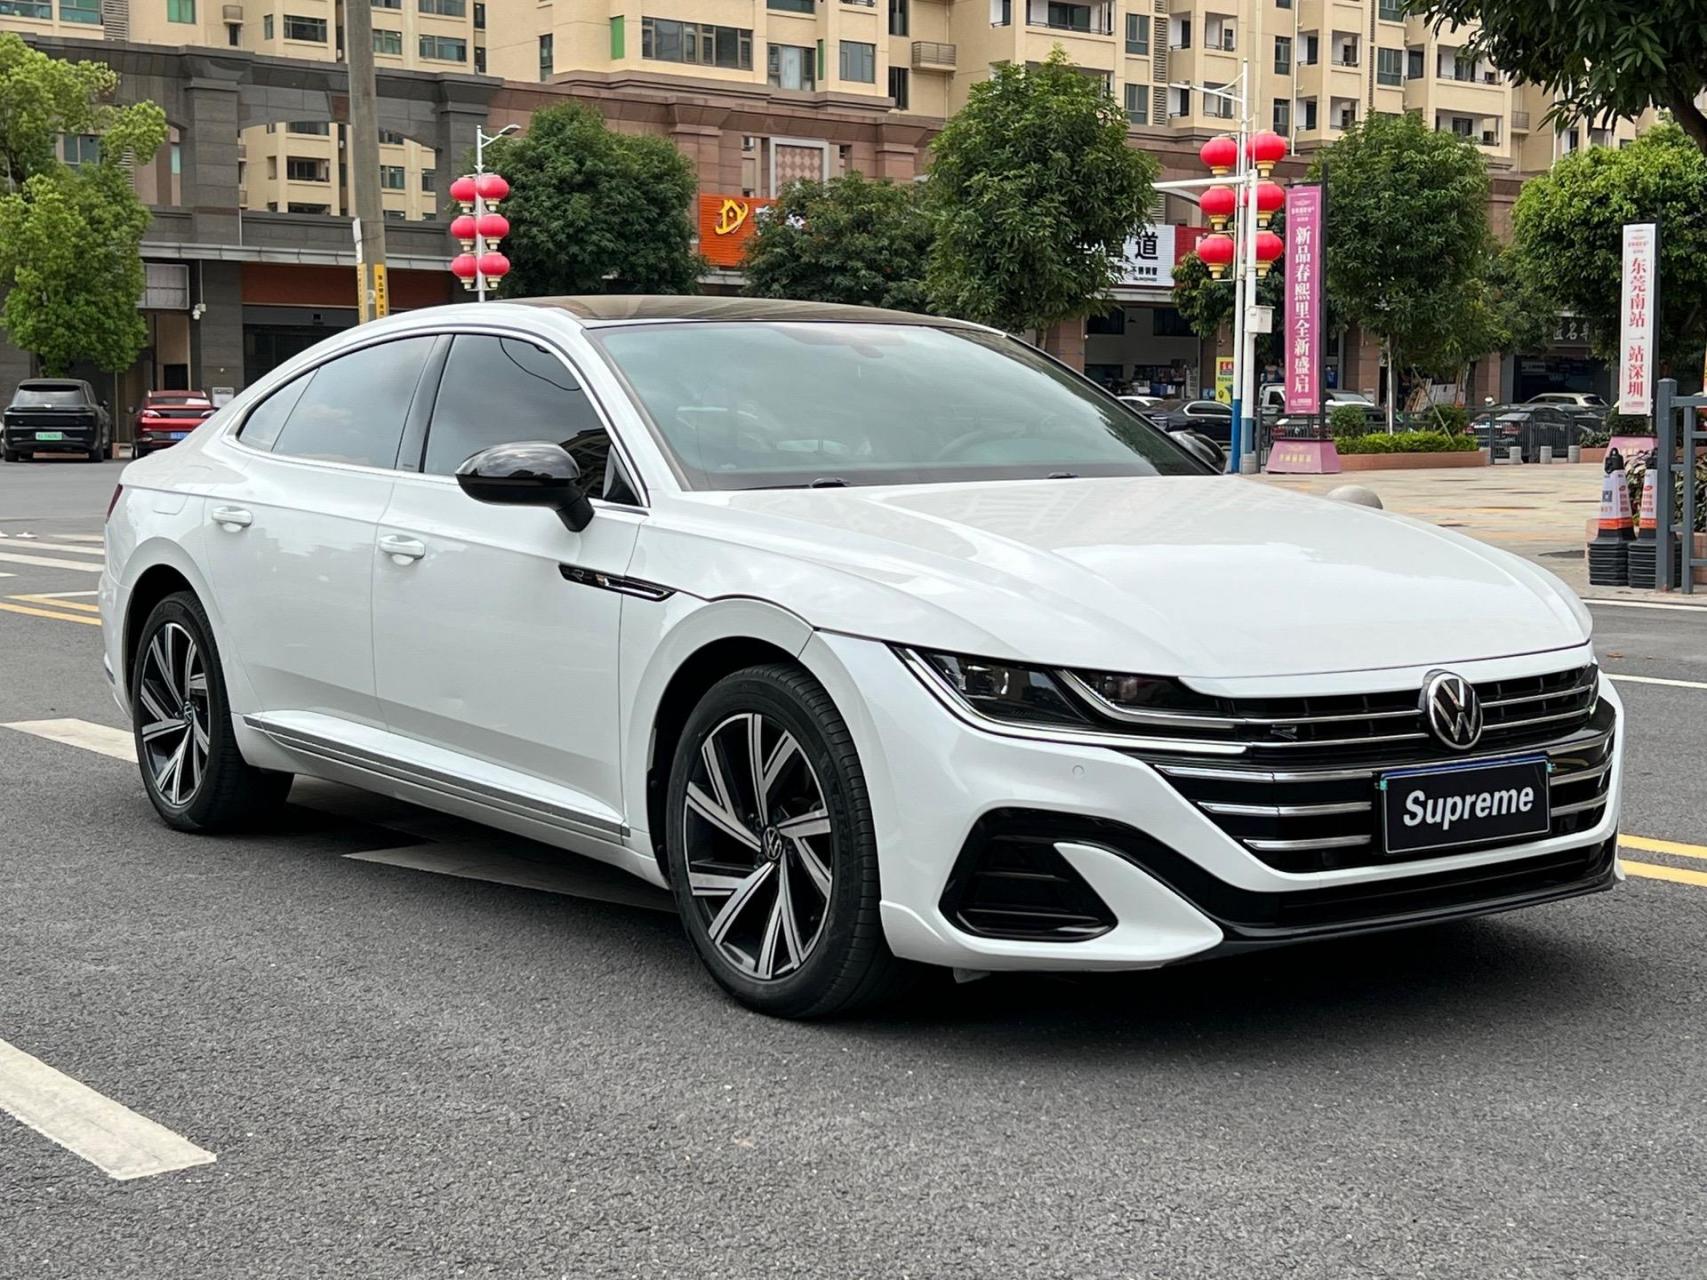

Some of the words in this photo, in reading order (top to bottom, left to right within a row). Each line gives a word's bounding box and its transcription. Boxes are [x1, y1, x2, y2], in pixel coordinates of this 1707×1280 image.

[1294, 225, 1312, 392] 新品春熙里全新盛启
[1403, 786, 1535, 831] Supreme
